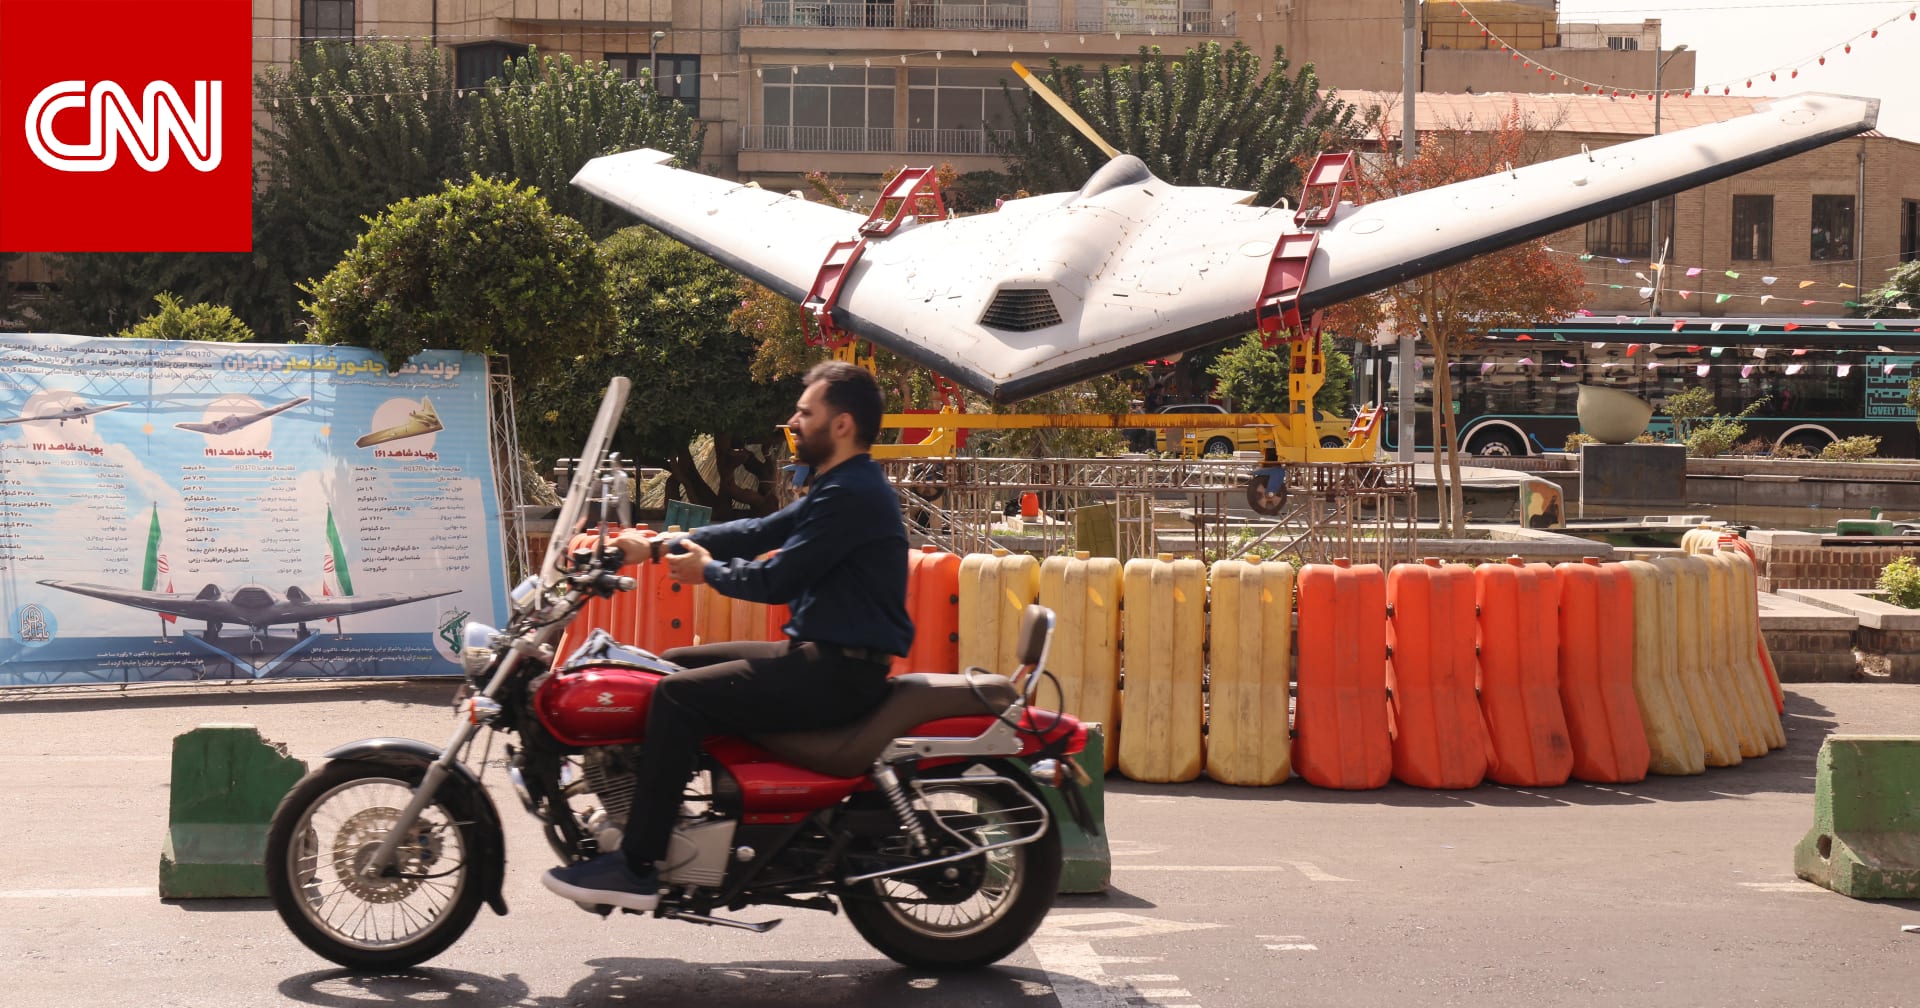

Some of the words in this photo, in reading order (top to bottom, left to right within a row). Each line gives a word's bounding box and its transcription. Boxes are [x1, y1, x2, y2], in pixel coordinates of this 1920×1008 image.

[186, 350, 211, 358] RQ170
[224, 354, 263, 373] ایران
[264, 357, 283, 373] در
[282, 356, 337, 374] قندهار
[337, 360, 384, 376] جانور
[420, 362, 460, 380] تولید
[1868, 406, 1895, 416] LOVELY
[32, 443, 46, 451] ۱۷۱
[48, 442, 76, 451] شاهد
[78, 444, 104, 456] پهپاد
[205, 448, 217, 456] ۱۹۱
[219, 448, 245, 456] شاهد
[246, 448, 272, 459] پهپاد
[388, 449, 413, 457] شاهد
[414, 450, 438, 460] پهپاد
